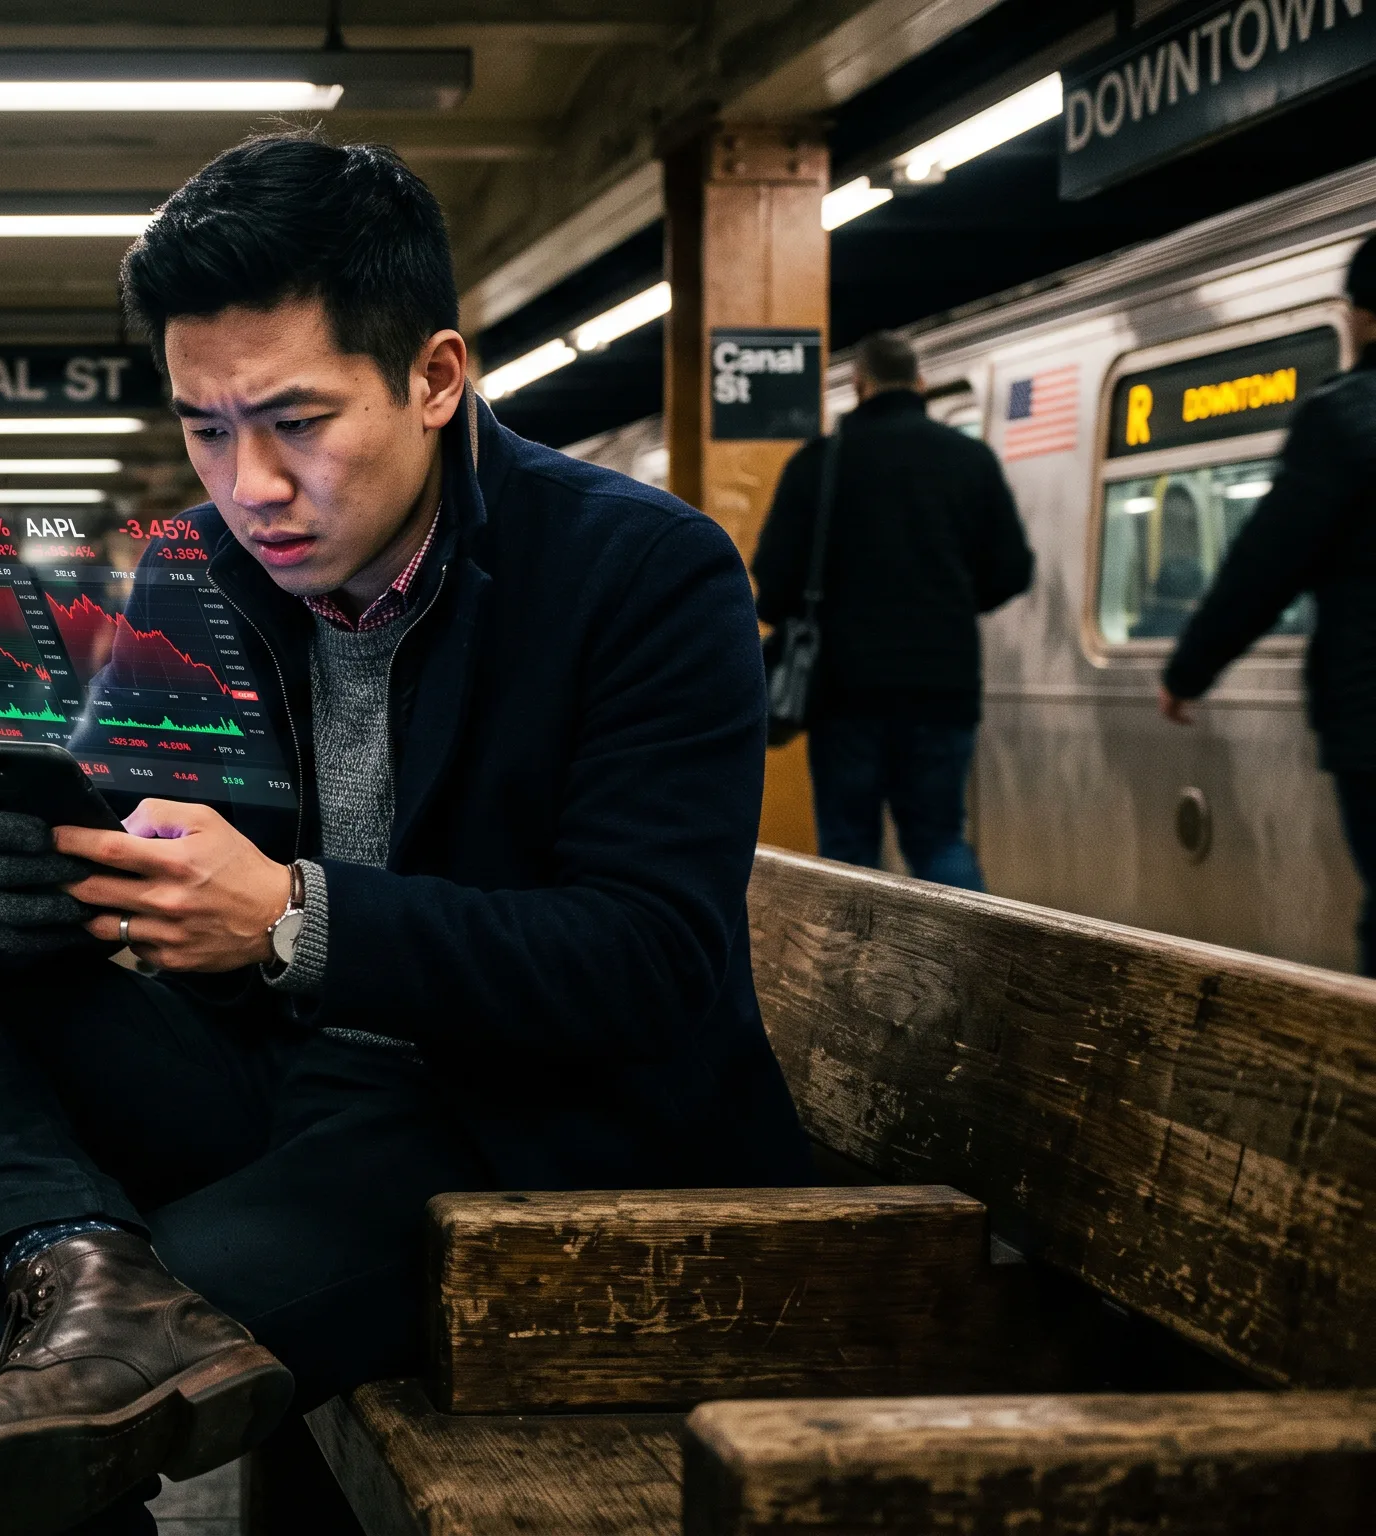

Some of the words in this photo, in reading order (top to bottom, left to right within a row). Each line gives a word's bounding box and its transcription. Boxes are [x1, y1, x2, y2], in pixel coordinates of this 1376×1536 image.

[713, 341, 805, 374] Canal
[64, 356, 130, 402] ST
[714, 373, 752, 405] St
[1125, 383, 1154, 446] R
[1181, 367, 1298, 423] DOWNTOWN
[27, 518, 85, 538] AAPL
[119, 520, 200, 540] -3.45%
